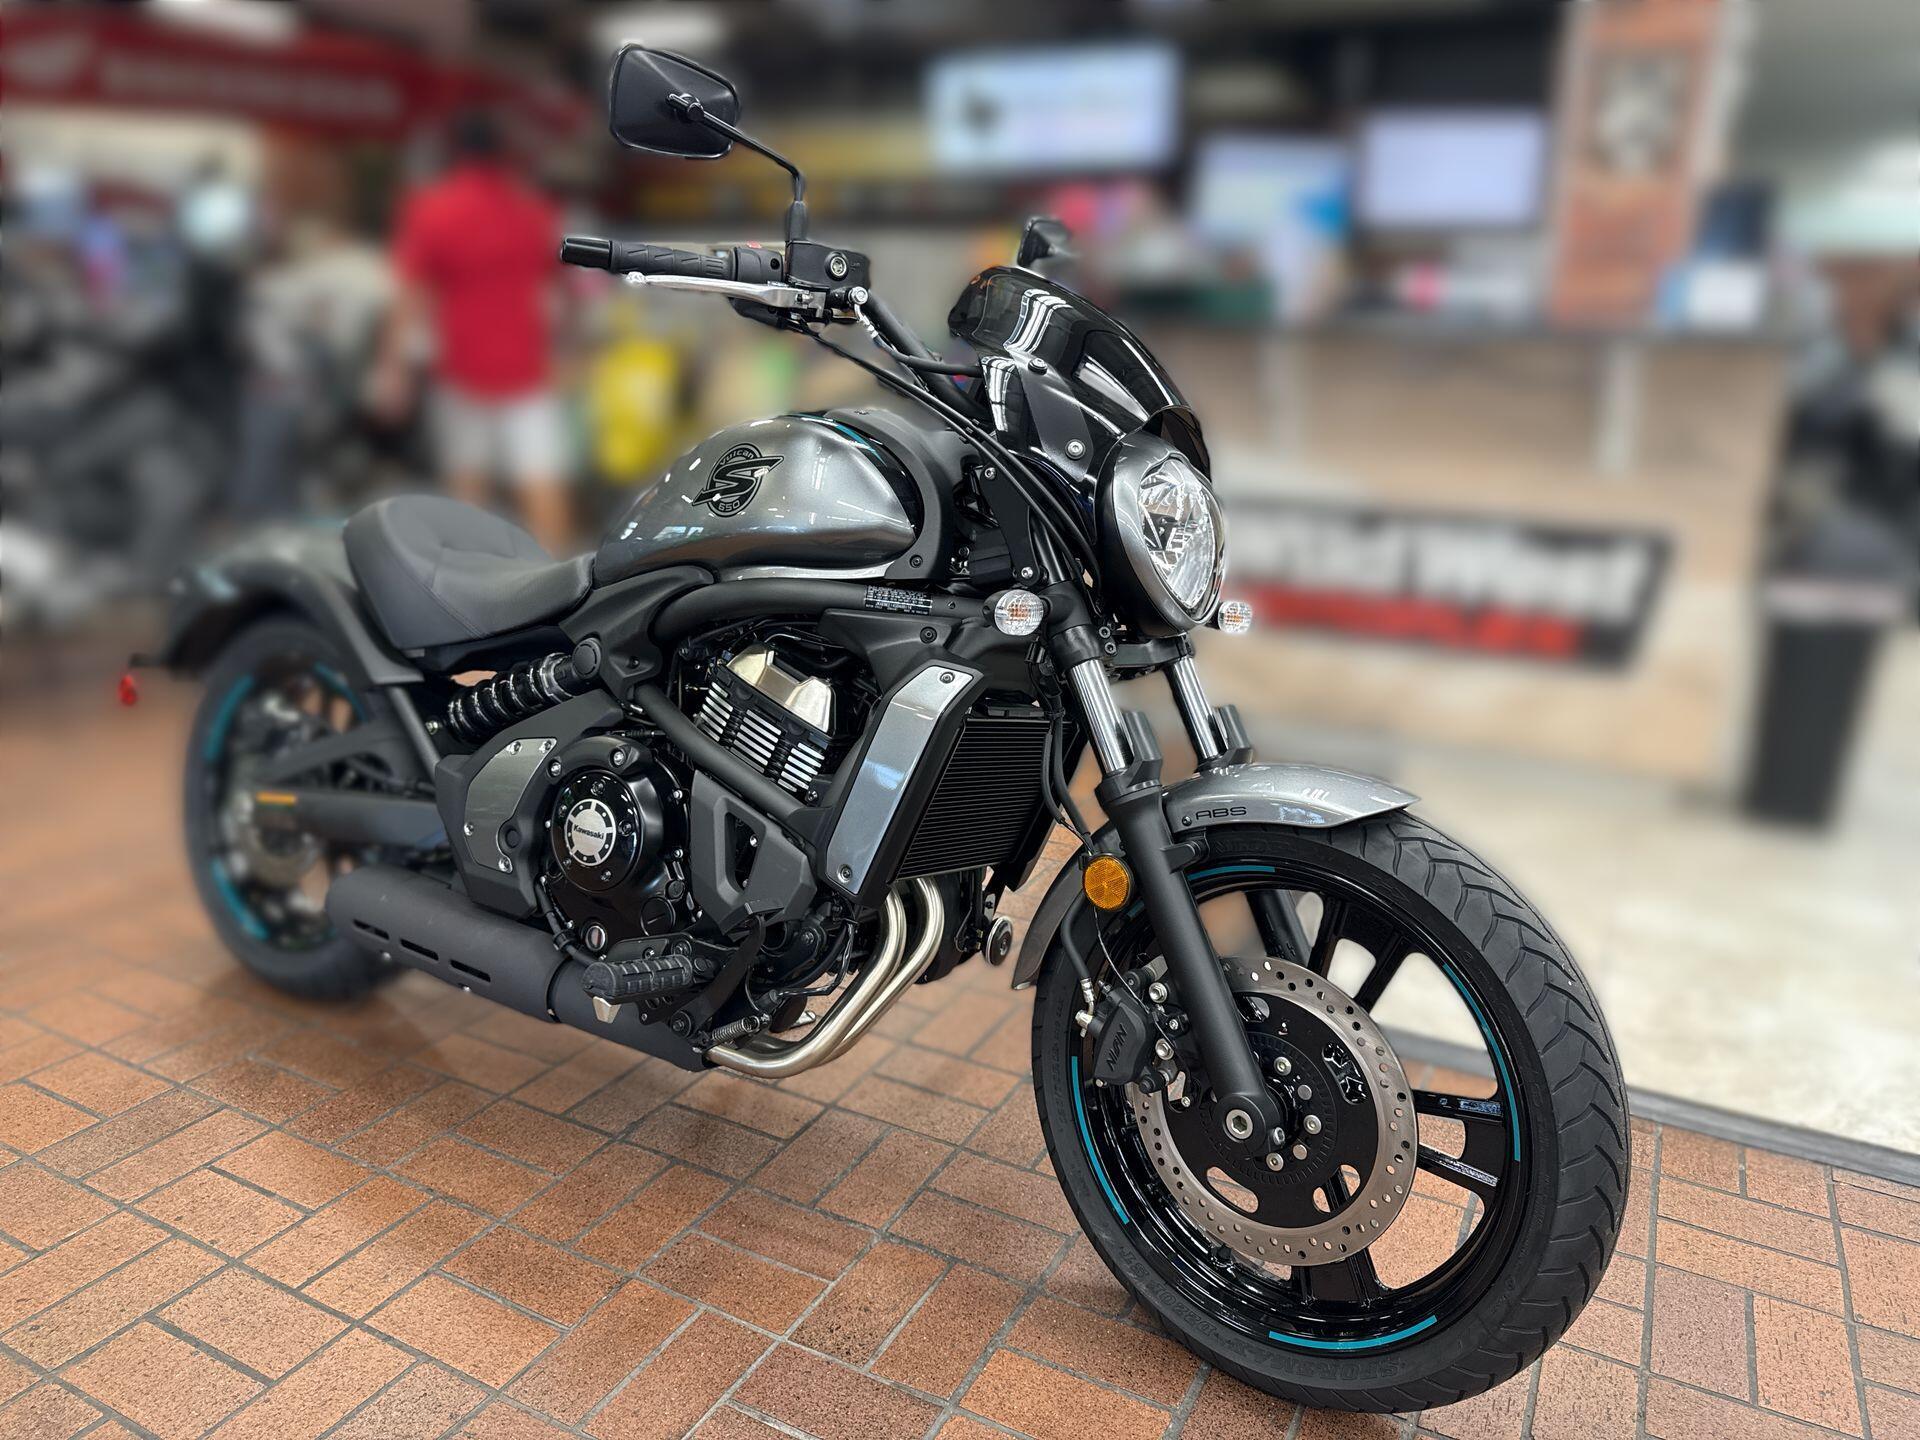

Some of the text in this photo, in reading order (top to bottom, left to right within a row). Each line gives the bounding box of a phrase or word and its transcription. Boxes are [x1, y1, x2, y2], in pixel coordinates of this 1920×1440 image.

[718, 499, 741, 511] 650
[1195, 806, 1247, 820] ABS
[573, 825, 605, 839] Kawasaki
